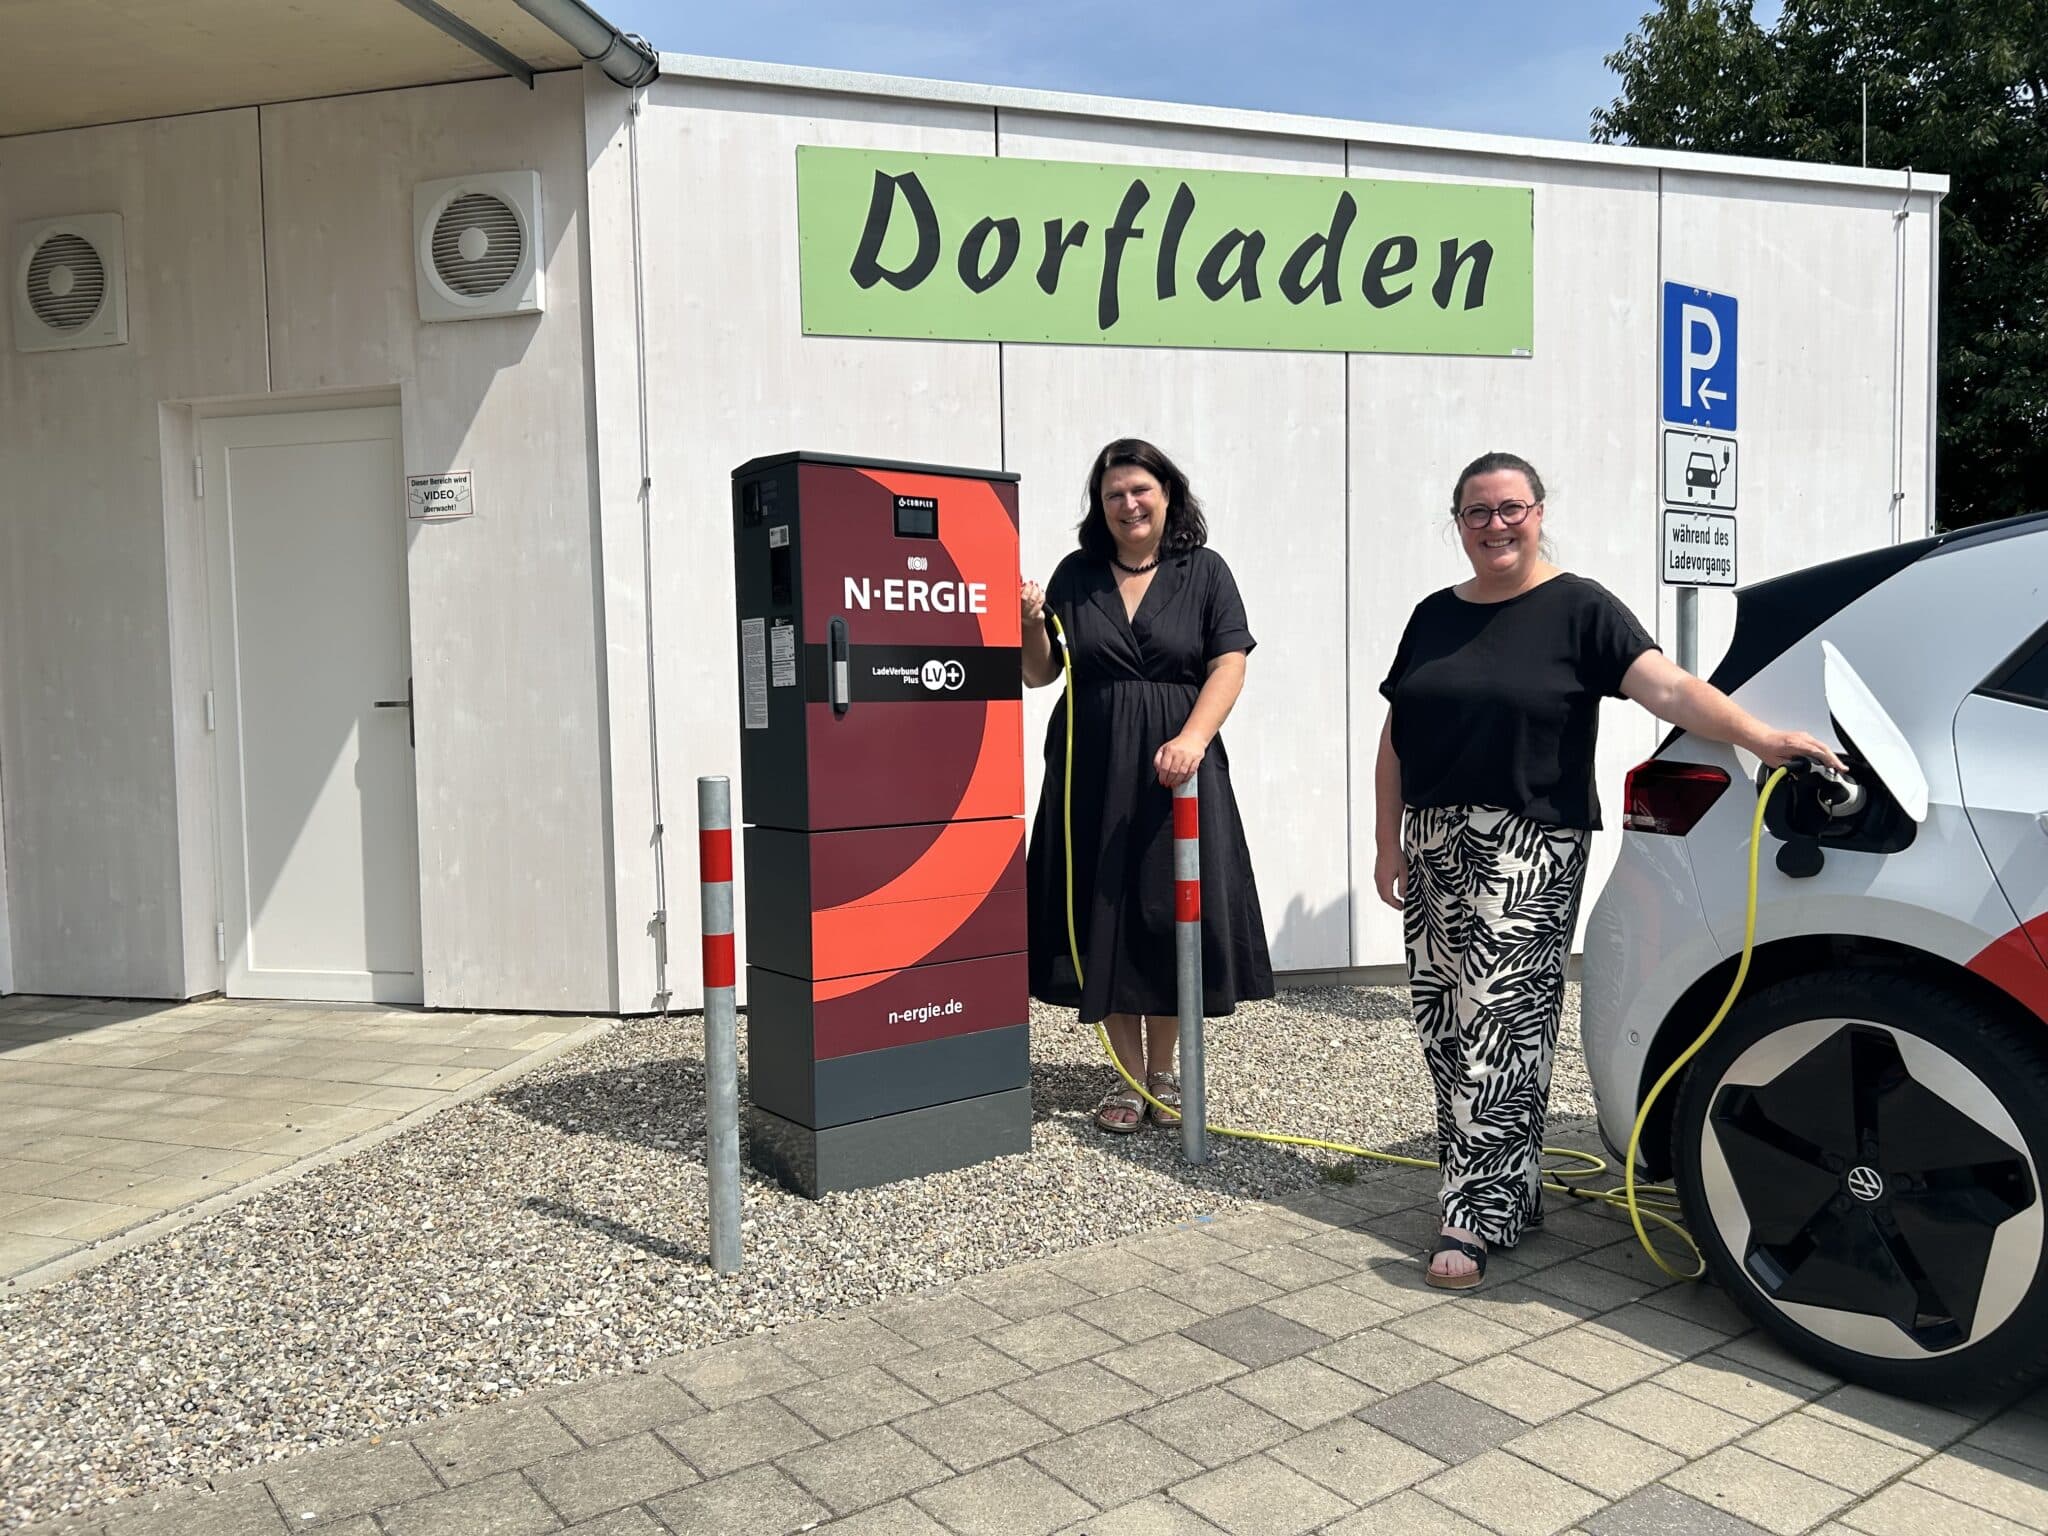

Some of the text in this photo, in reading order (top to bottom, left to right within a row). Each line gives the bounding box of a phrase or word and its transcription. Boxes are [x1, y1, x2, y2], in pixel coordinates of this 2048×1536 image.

[849, 169, 1495, 330] Dorfladen
[1681, 303, 1721, 408] P
[411, 479, 429, 487] Dieser
[430, 477, 452, 485] Bereich
[424, 489, 455, 500] VIDEO
[1672, 523, 1729, 546] während des
[1669, 549, 1731, 576] Ladevorgangs
[872, 666, 919, 676] LadeVerbund
[903, 675, 919, 684] Plus
[888, 998, 963, 1025] n-ergie.de
